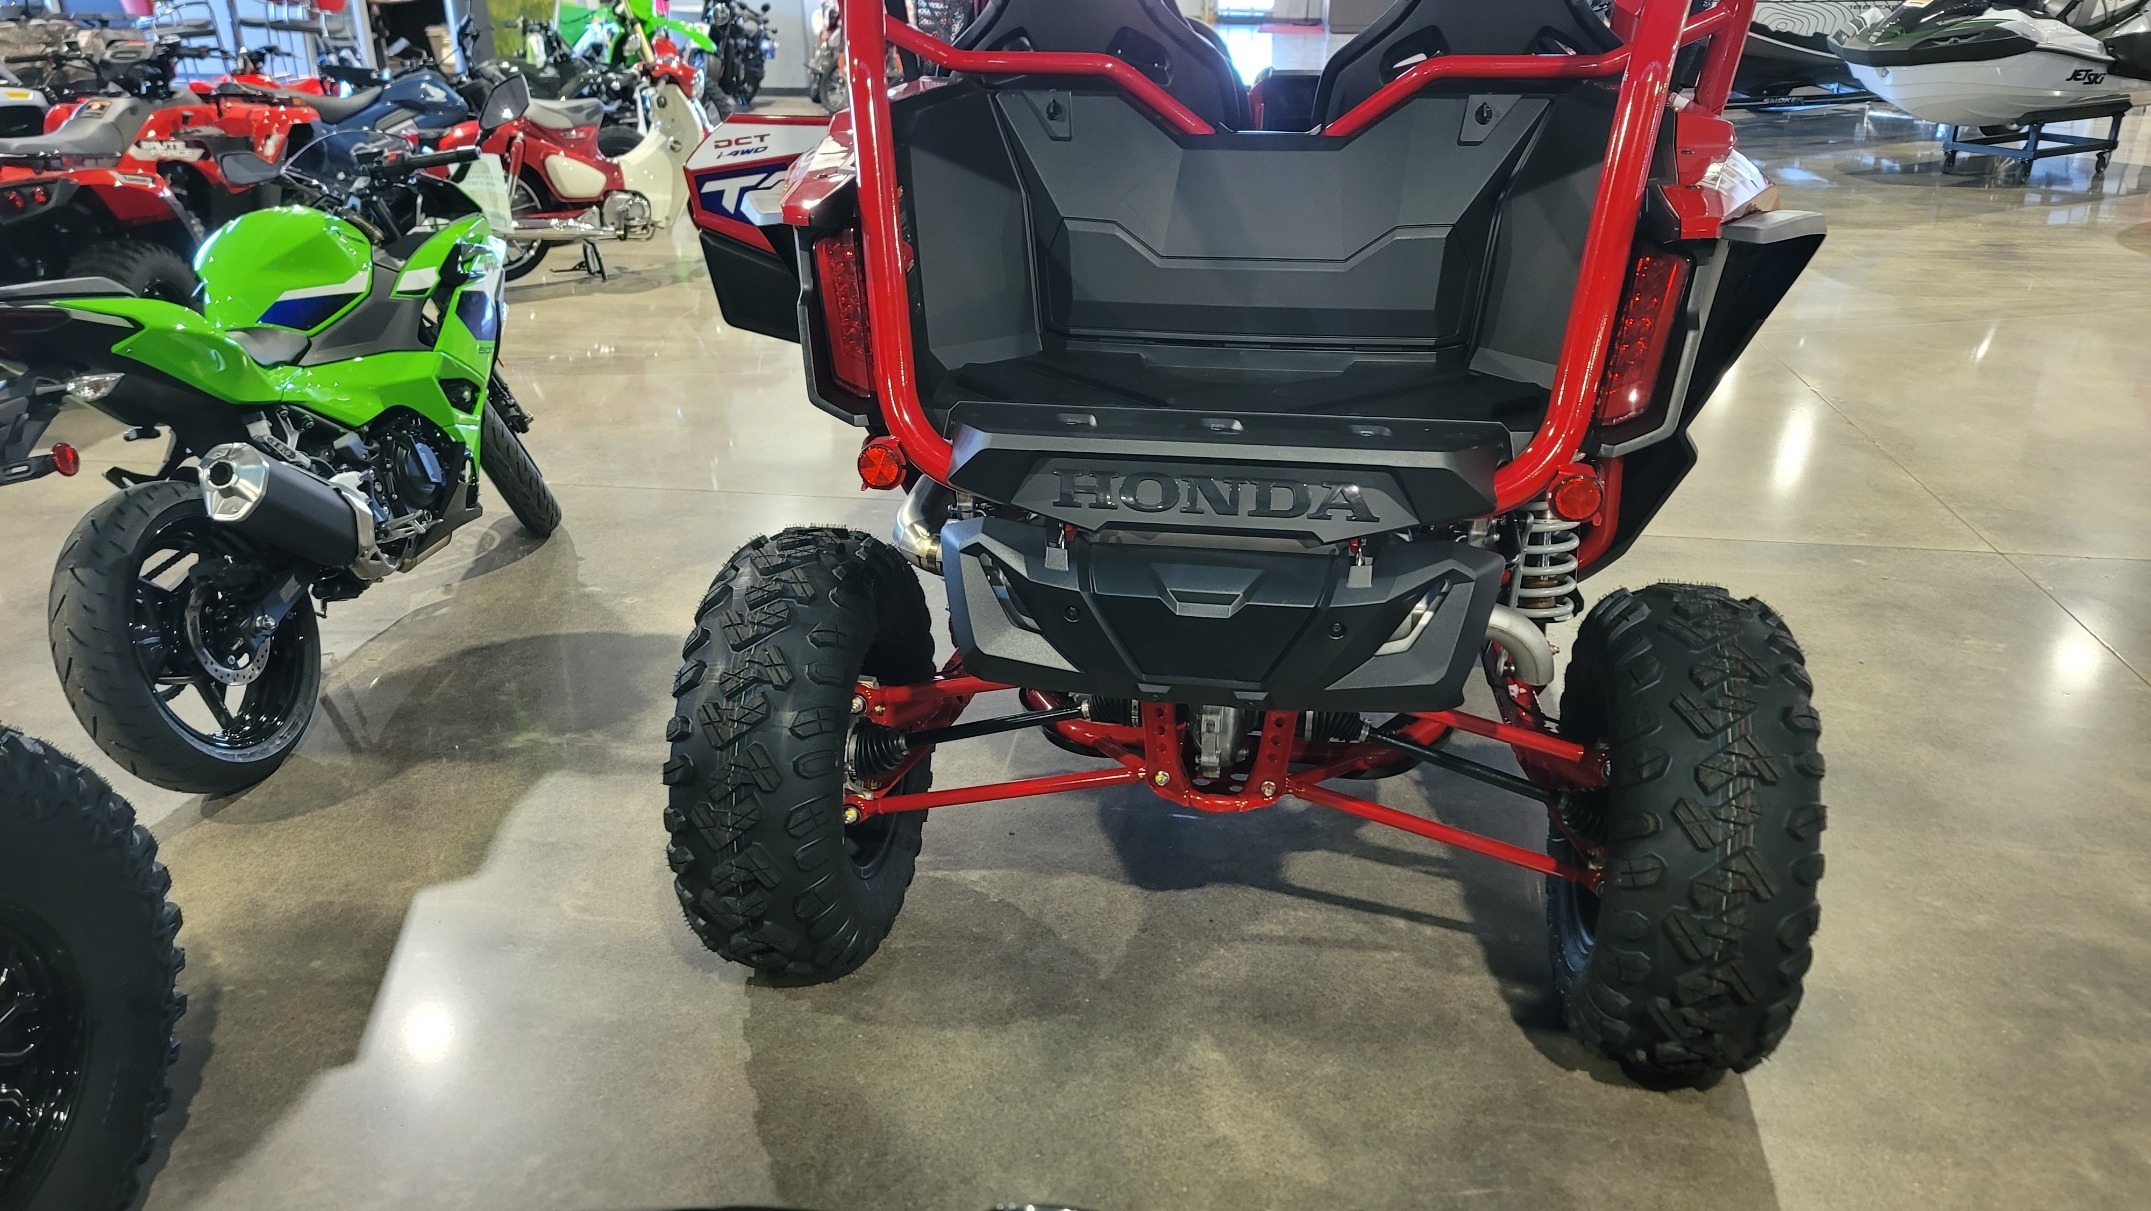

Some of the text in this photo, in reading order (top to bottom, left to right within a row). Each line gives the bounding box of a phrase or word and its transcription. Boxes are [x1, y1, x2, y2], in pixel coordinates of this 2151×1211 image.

[2065, 69, 2094, 82] JET
[1763, 97, 1805, 105] SMOKER
[140, 140, 187, 150] BRUTE
[714, 133, 772, 149] DCT
[1052, 468, 1380, 523] HONDA
